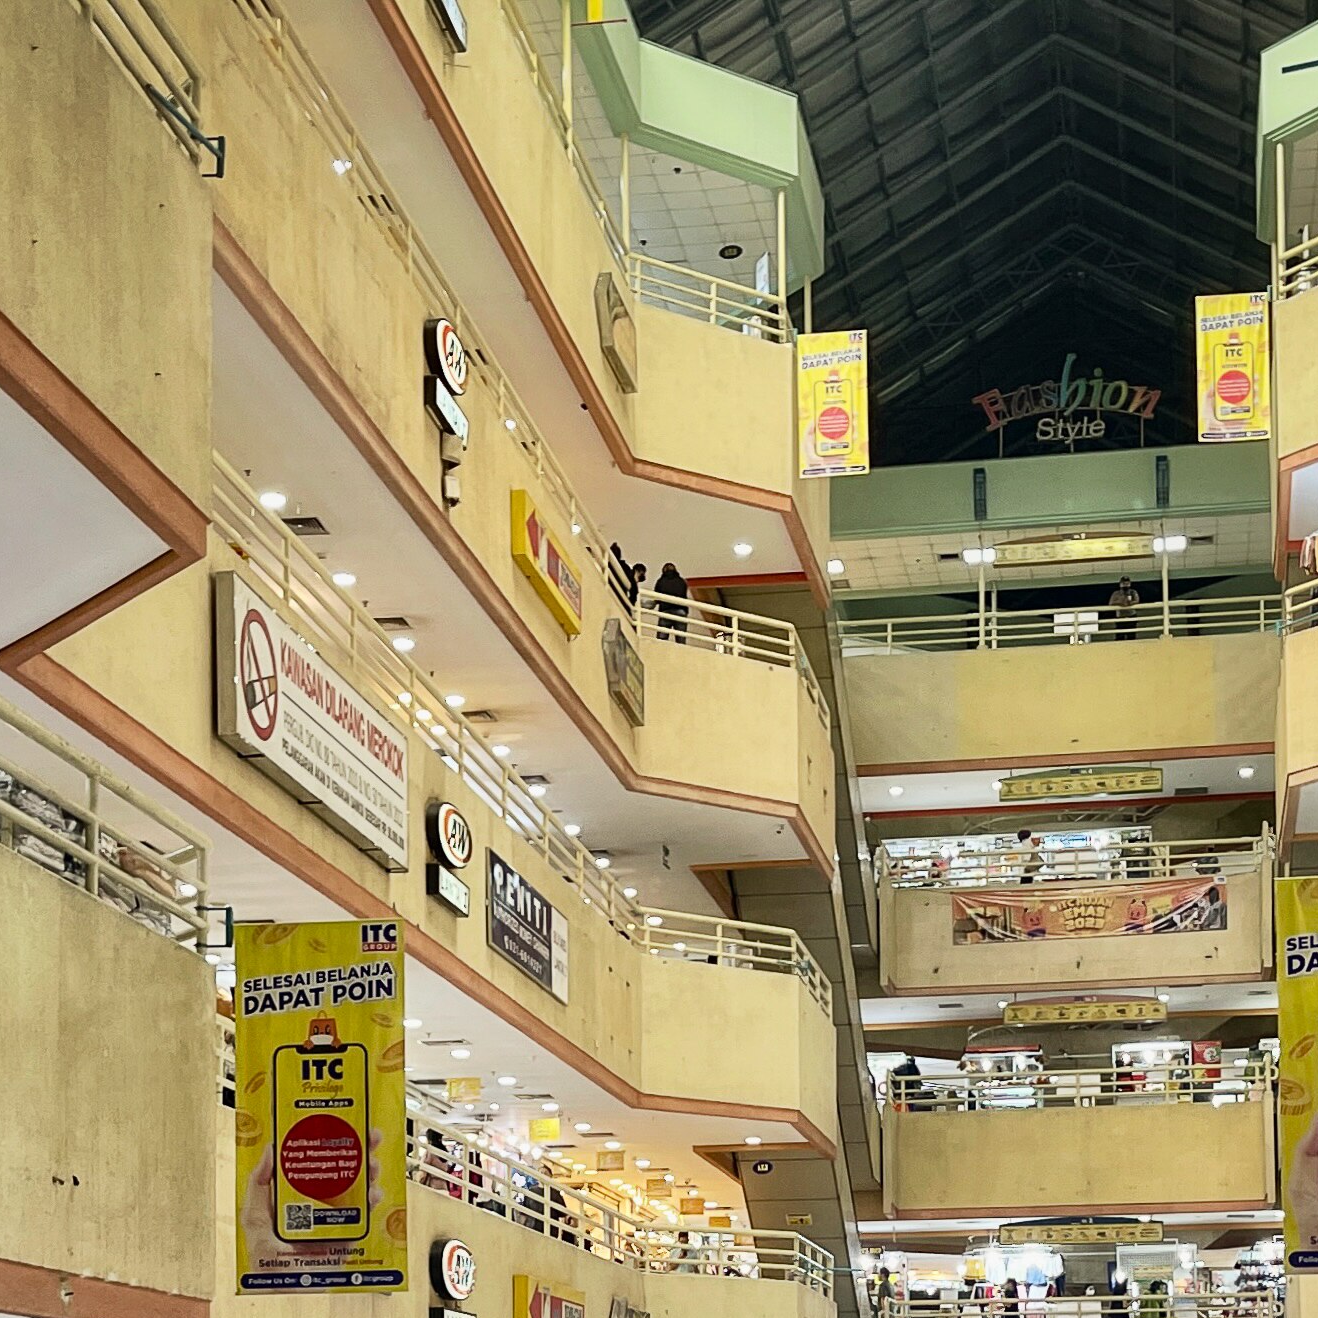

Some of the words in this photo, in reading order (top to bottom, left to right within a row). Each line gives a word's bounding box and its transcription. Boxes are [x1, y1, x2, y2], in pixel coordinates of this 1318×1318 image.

[1225, 348, 1243, 357] ITC
[802, 359, 833, 370] DAPAT
[825, 385, 842, 394] ITC
[972, 353, 1162, 432] Fashion
[1036, 416, 1105, 444] Style
[280, 637, 324, 710] KAWASAN
[325, 679, 366, 748] DILARANG
[366, 719, 405, 782] MEROKOK
[493, 863, 548, 936] PENITI
[362, 924, 397, 943] ITC
[362, 943, 397, 951] GROUP
[243, 972, 311, 993] SELESAI
[315, 962, 393, 984] BELANJA
[244, 986, 325, 1016] DAPAT
[332, 978, 393, 1004] POIN
[302, 1058, 343, 1080] ITC
[282, 1150, 305, 1159] Yang
[340, 1170, 355, 1178] ITC
[329, 1246, 365, 1257] Untung
[258, 1258, 291, 1269] Setiap
[293, 1257, 341, 1267] Transaksi
